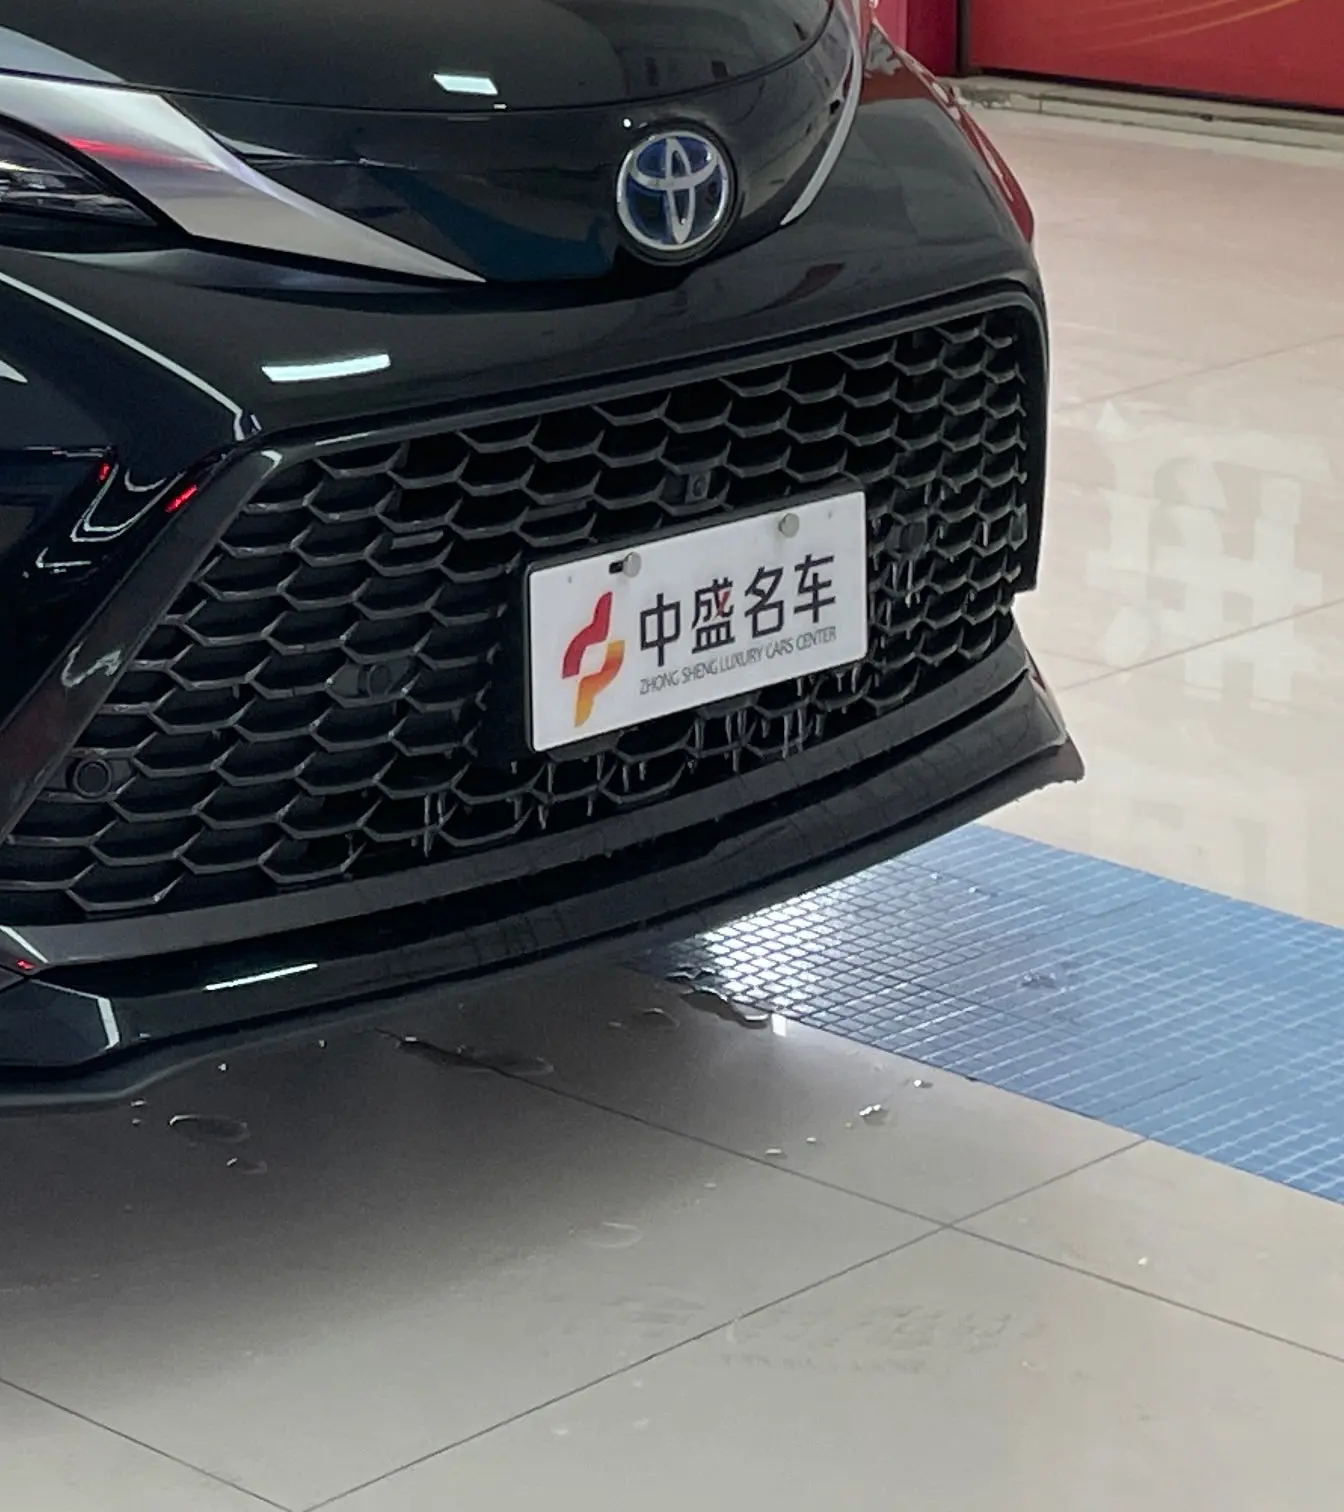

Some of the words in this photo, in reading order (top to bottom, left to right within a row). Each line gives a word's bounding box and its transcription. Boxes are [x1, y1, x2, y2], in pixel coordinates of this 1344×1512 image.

[640, 554, 836, 667] 中盛名车
[640, 668, 681, 695] ZHONG
[680, 655, 718, 684] SHENG
[718, 644, 765, 674] LUXURY
[765, 638, 794, 660] CARS
[795, 625, 837, 651] CENTER
